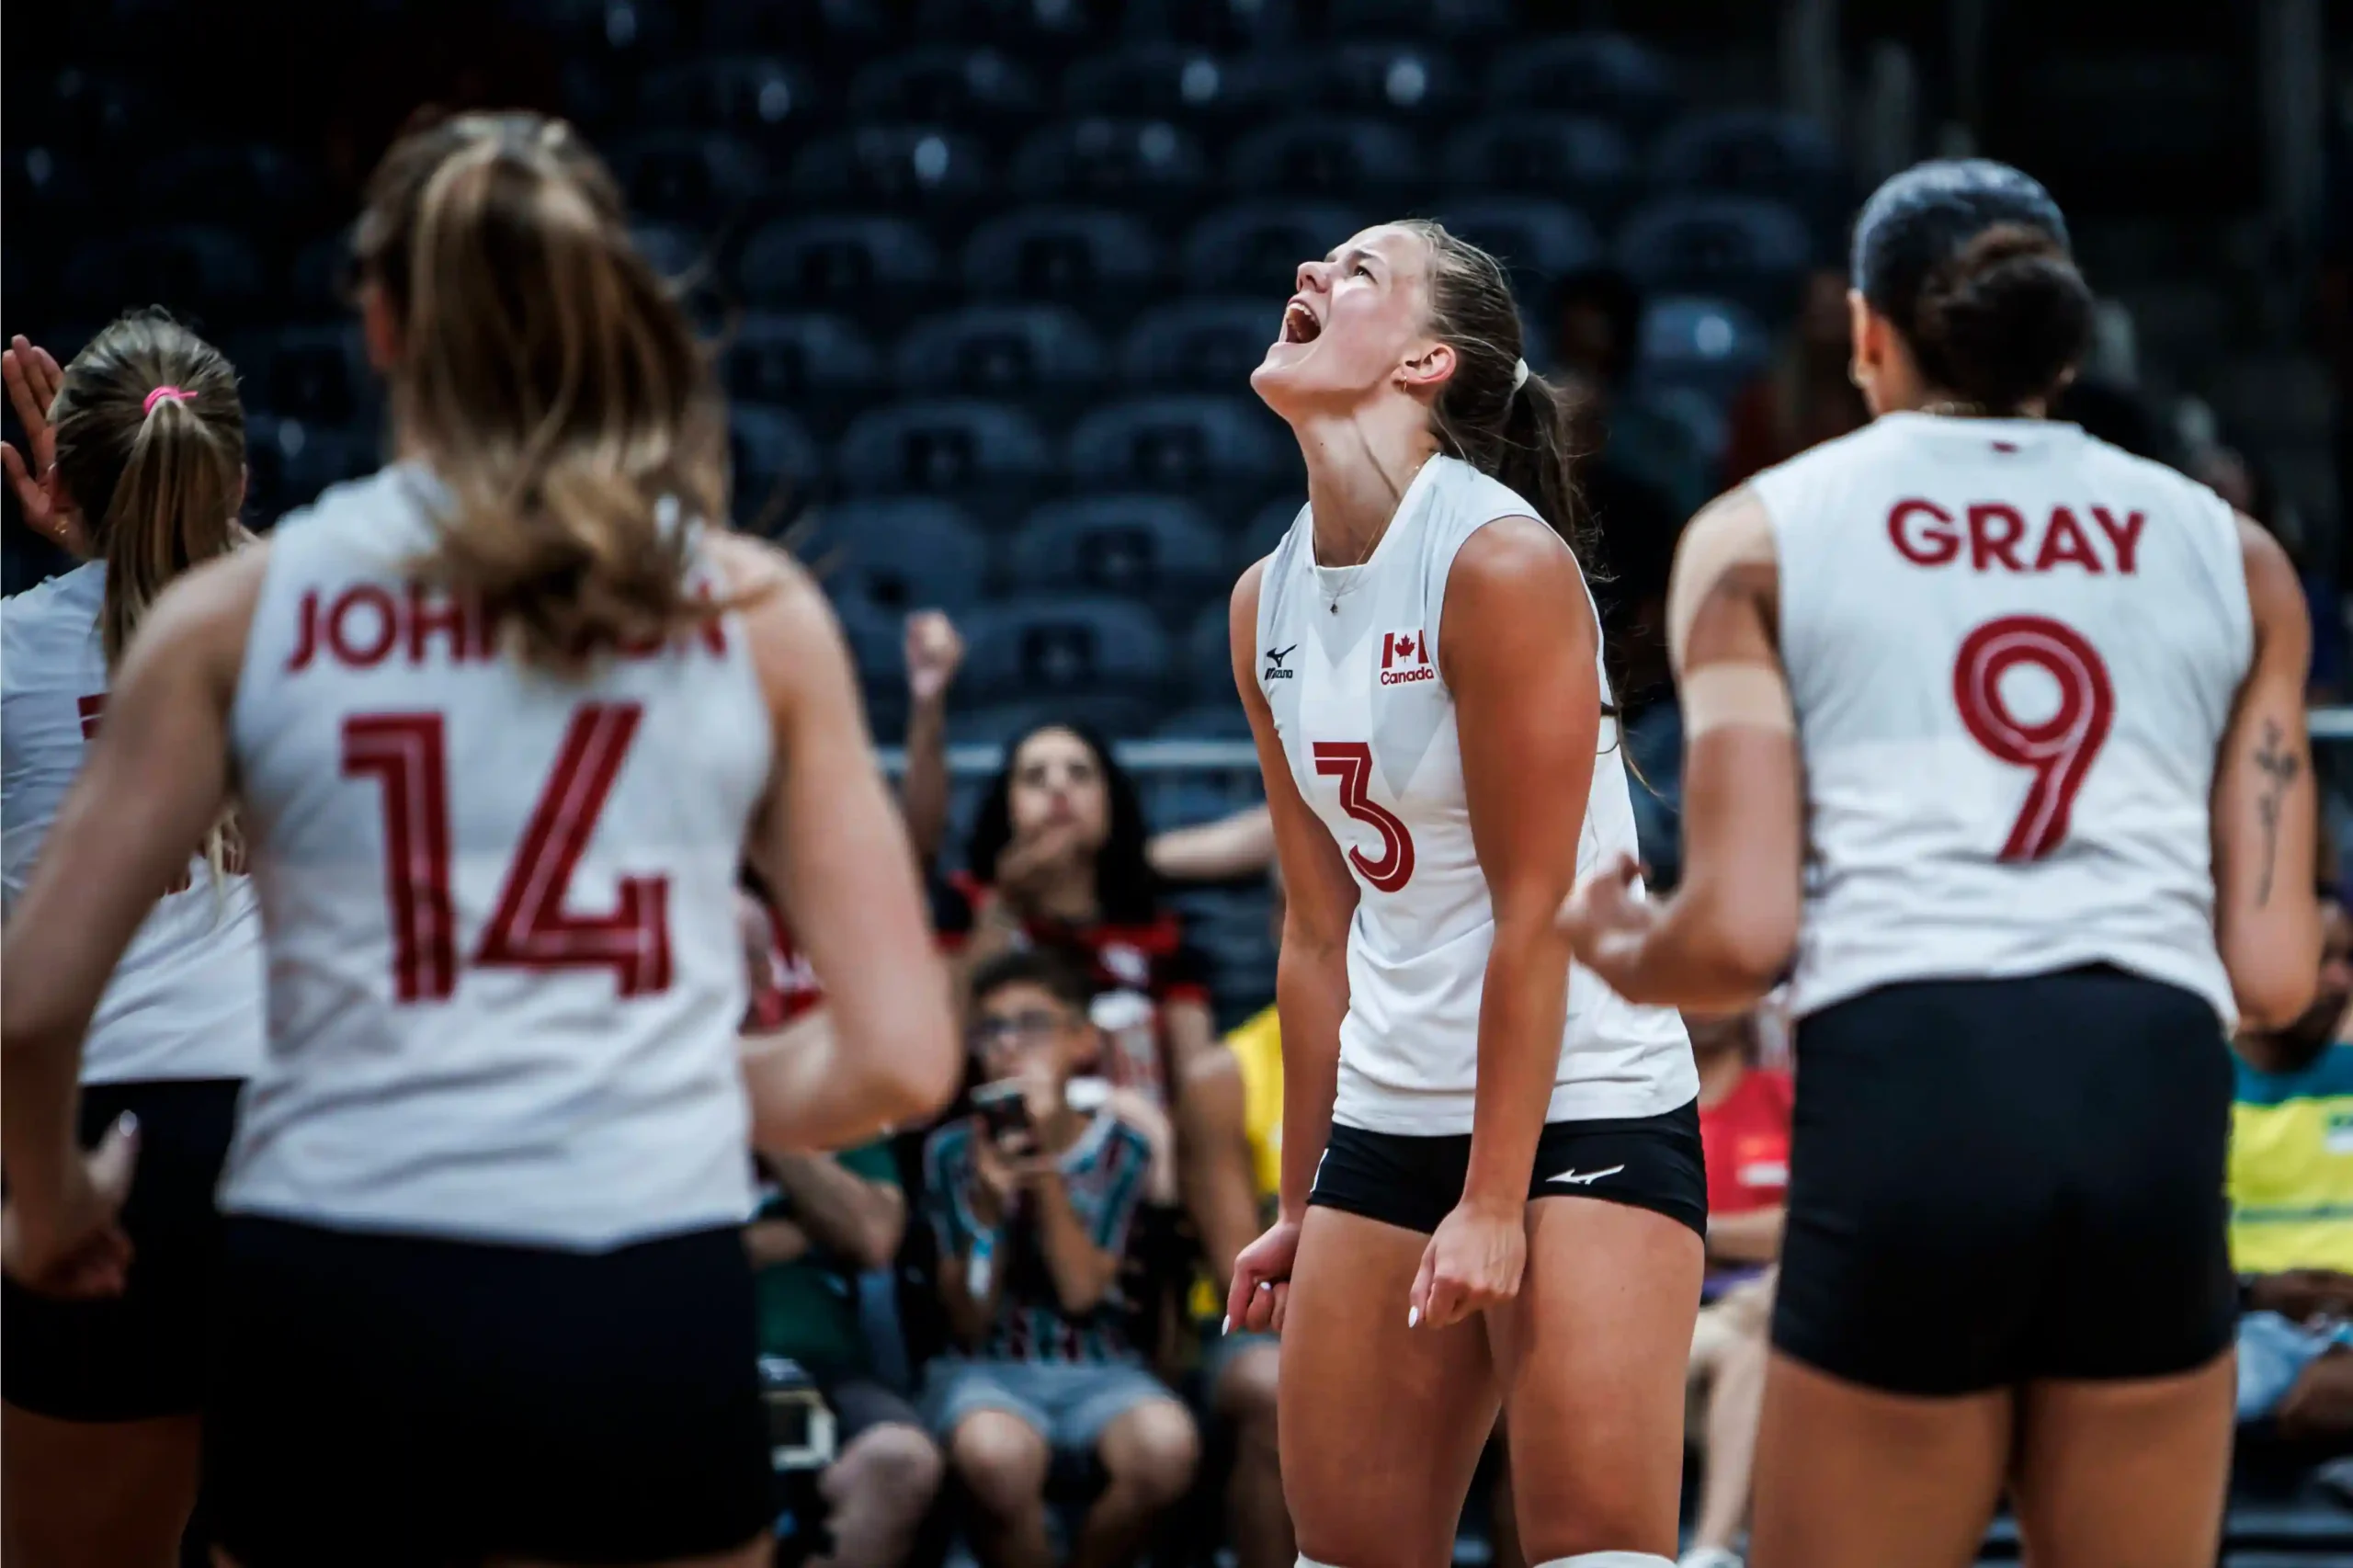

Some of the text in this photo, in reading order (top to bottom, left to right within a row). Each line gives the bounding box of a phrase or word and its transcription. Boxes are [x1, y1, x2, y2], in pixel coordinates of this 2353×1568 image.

[1887, 496, 2146, 575] GRAY
[1381, 666, 1434, 685] Canada
[1952, 613, 2114, 862] 9
[340, 701, 673, 1005] 14
[1313, 742, 1415, 892] 3
